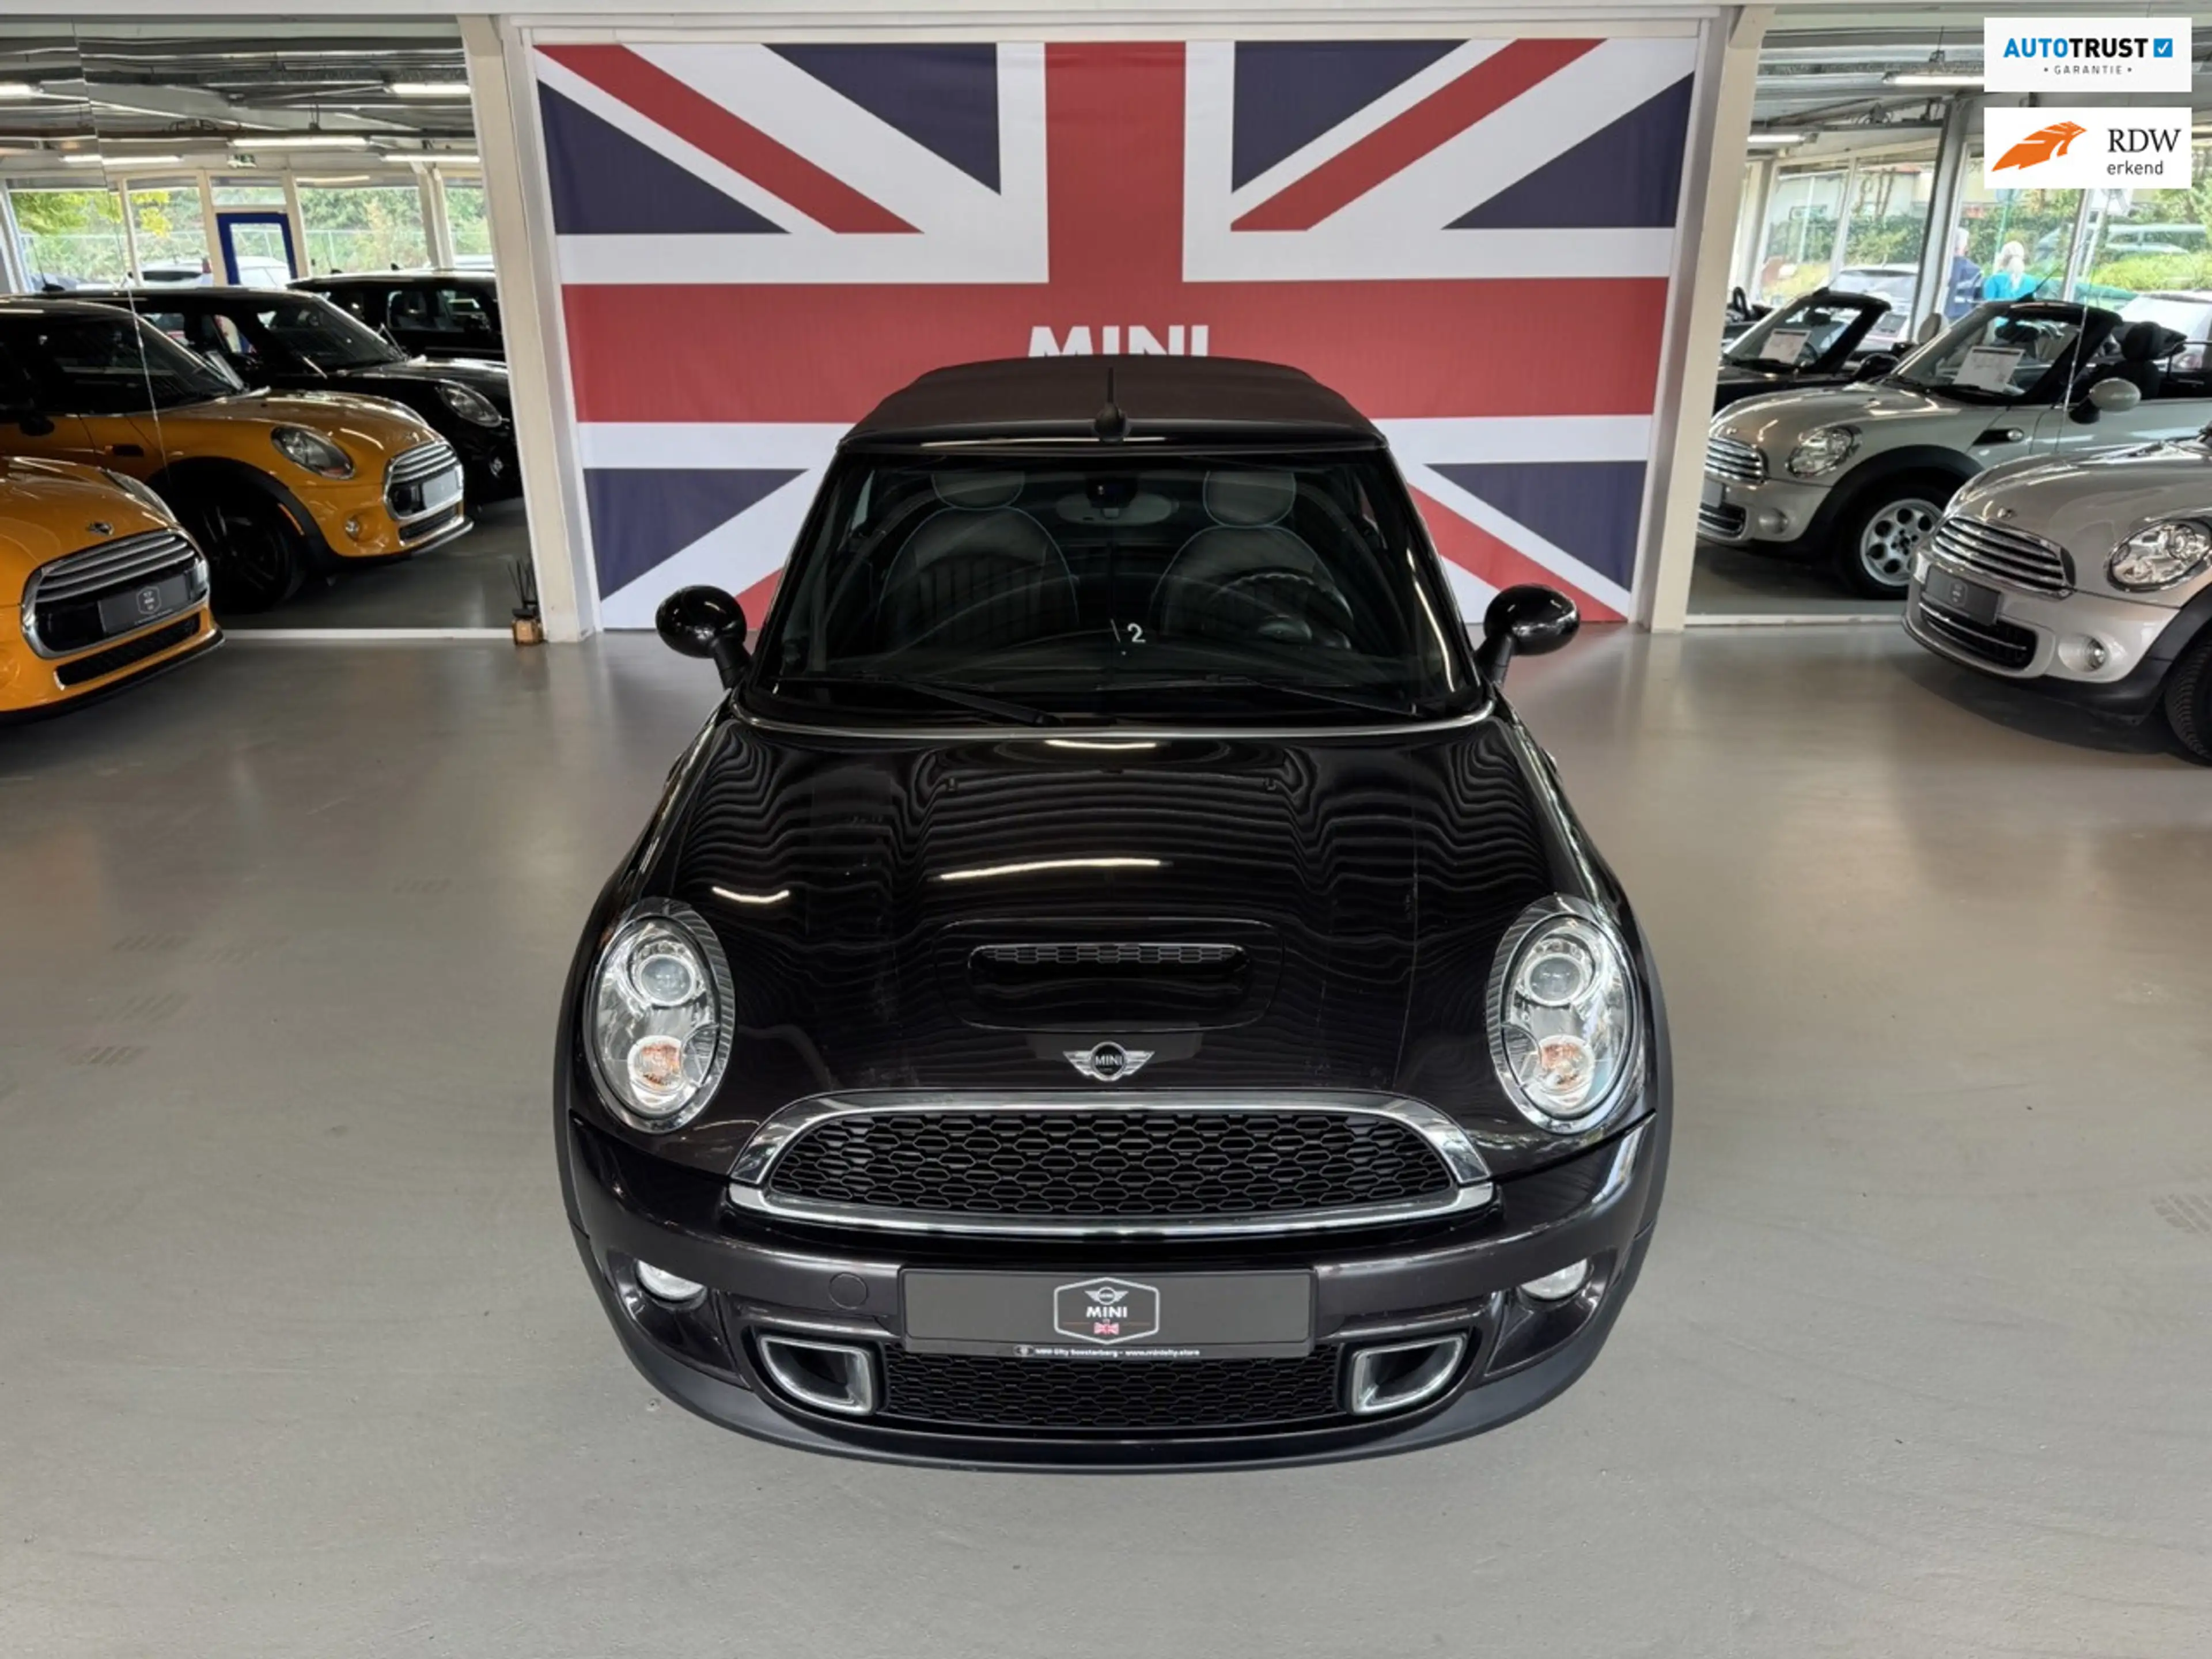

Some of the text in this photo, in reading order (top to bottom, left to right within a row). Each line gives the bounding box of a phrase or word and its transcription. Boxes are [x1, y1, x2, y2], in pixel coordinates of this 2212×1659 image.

[1028, 324, 1209, 357] MINI
[1095, 1054, 1122, 1066] MINI
[1086, 1306, 1128, 1318] MINI
